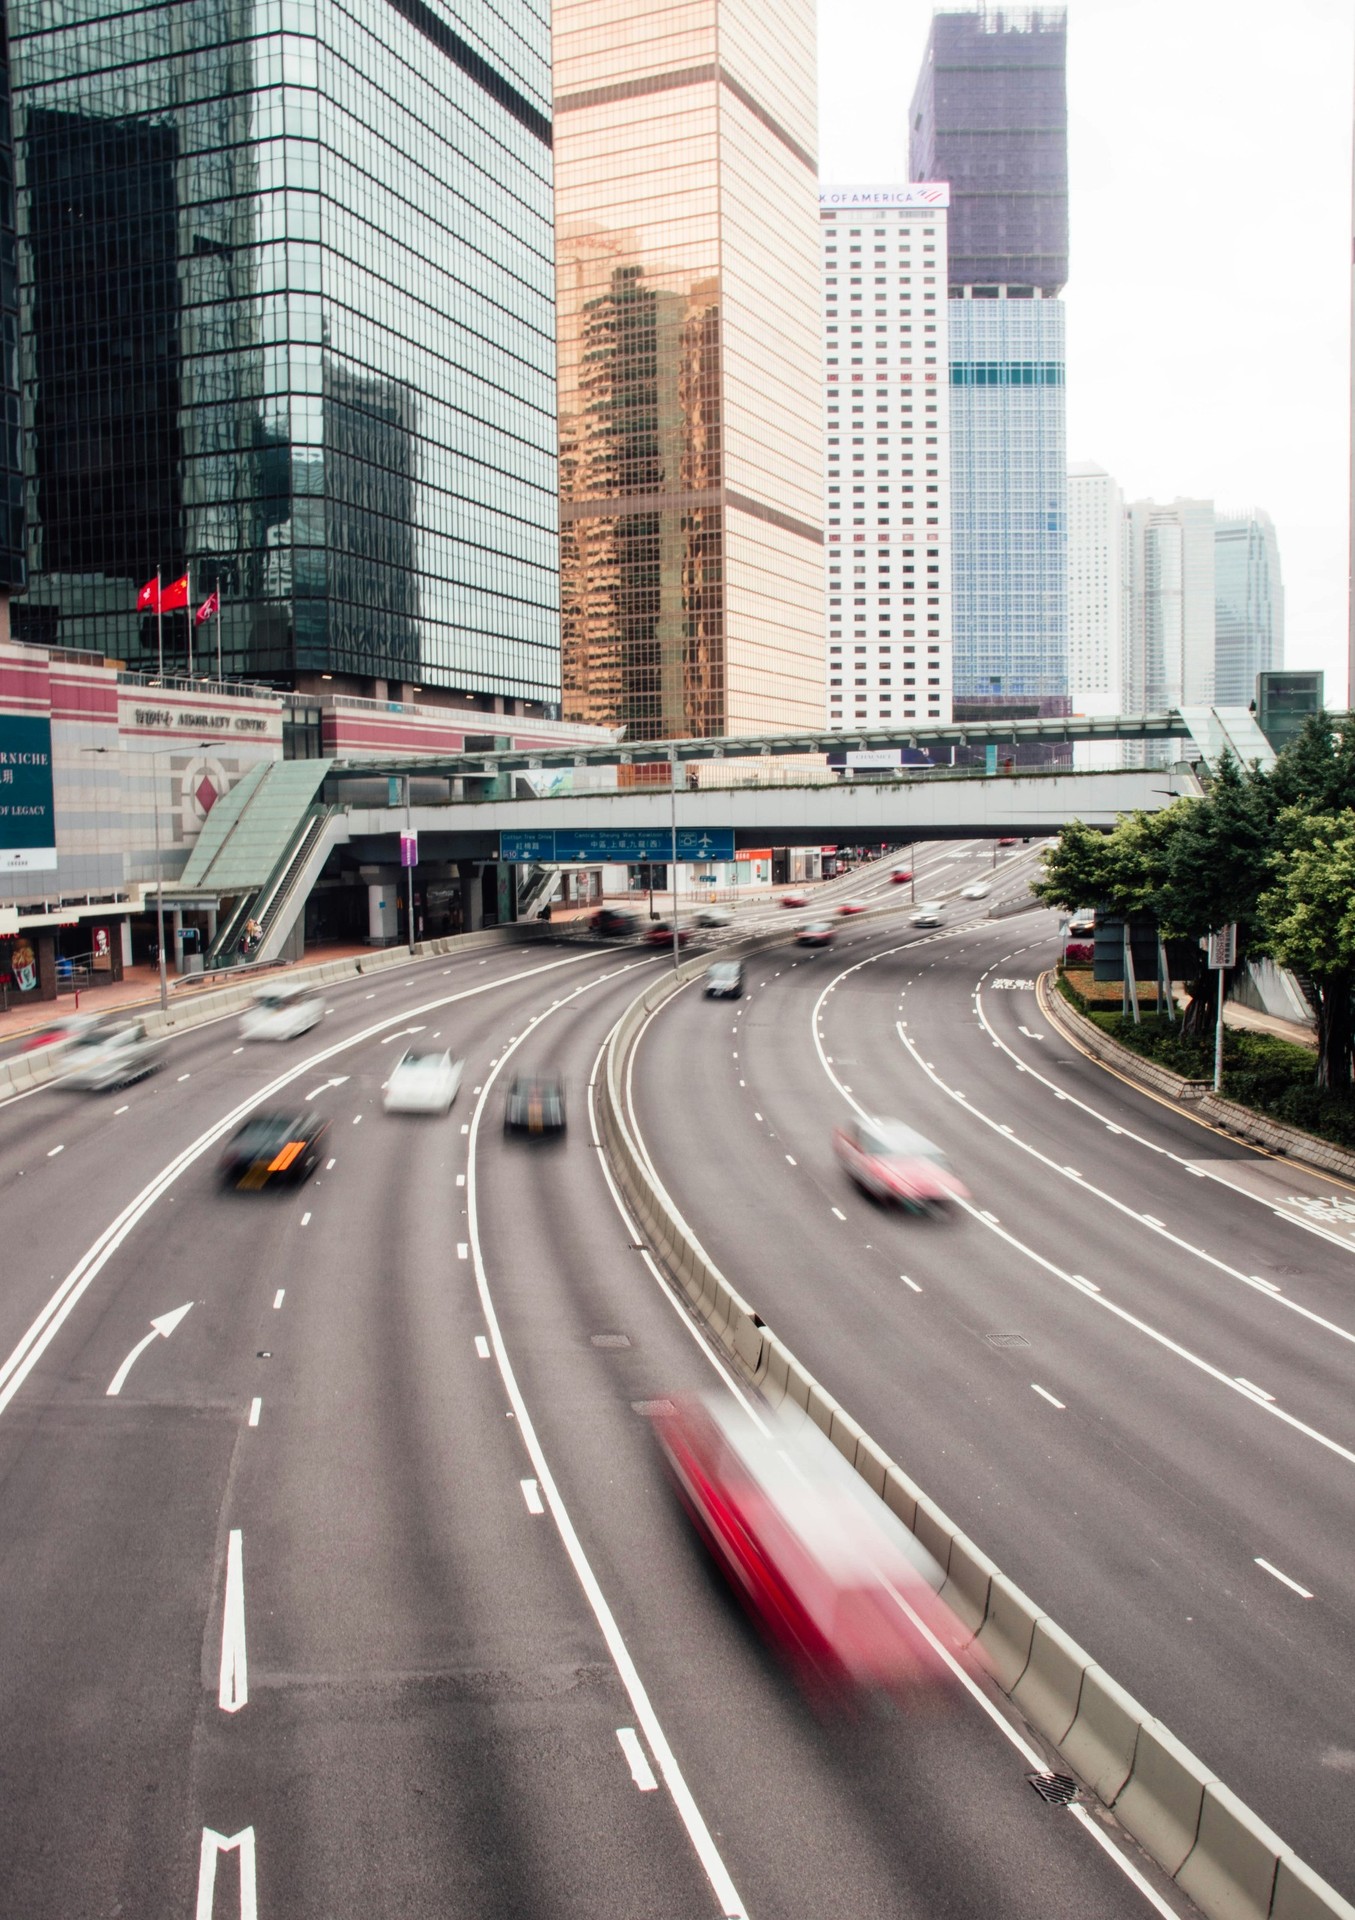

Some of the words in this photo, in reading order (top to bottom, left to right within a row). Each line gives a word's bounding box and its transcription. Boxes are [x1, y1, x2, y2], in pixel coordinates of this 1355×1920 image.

[831, 194, 848, 203] OF
[852, 193, 913, 203] AMERICA
[235, 717, 268, 732] CENTRE
[0, 752, 48, 766] RNICHE
[0, 769, 13, 785] 玥
[12, 805, 45, 816] LEGACY
